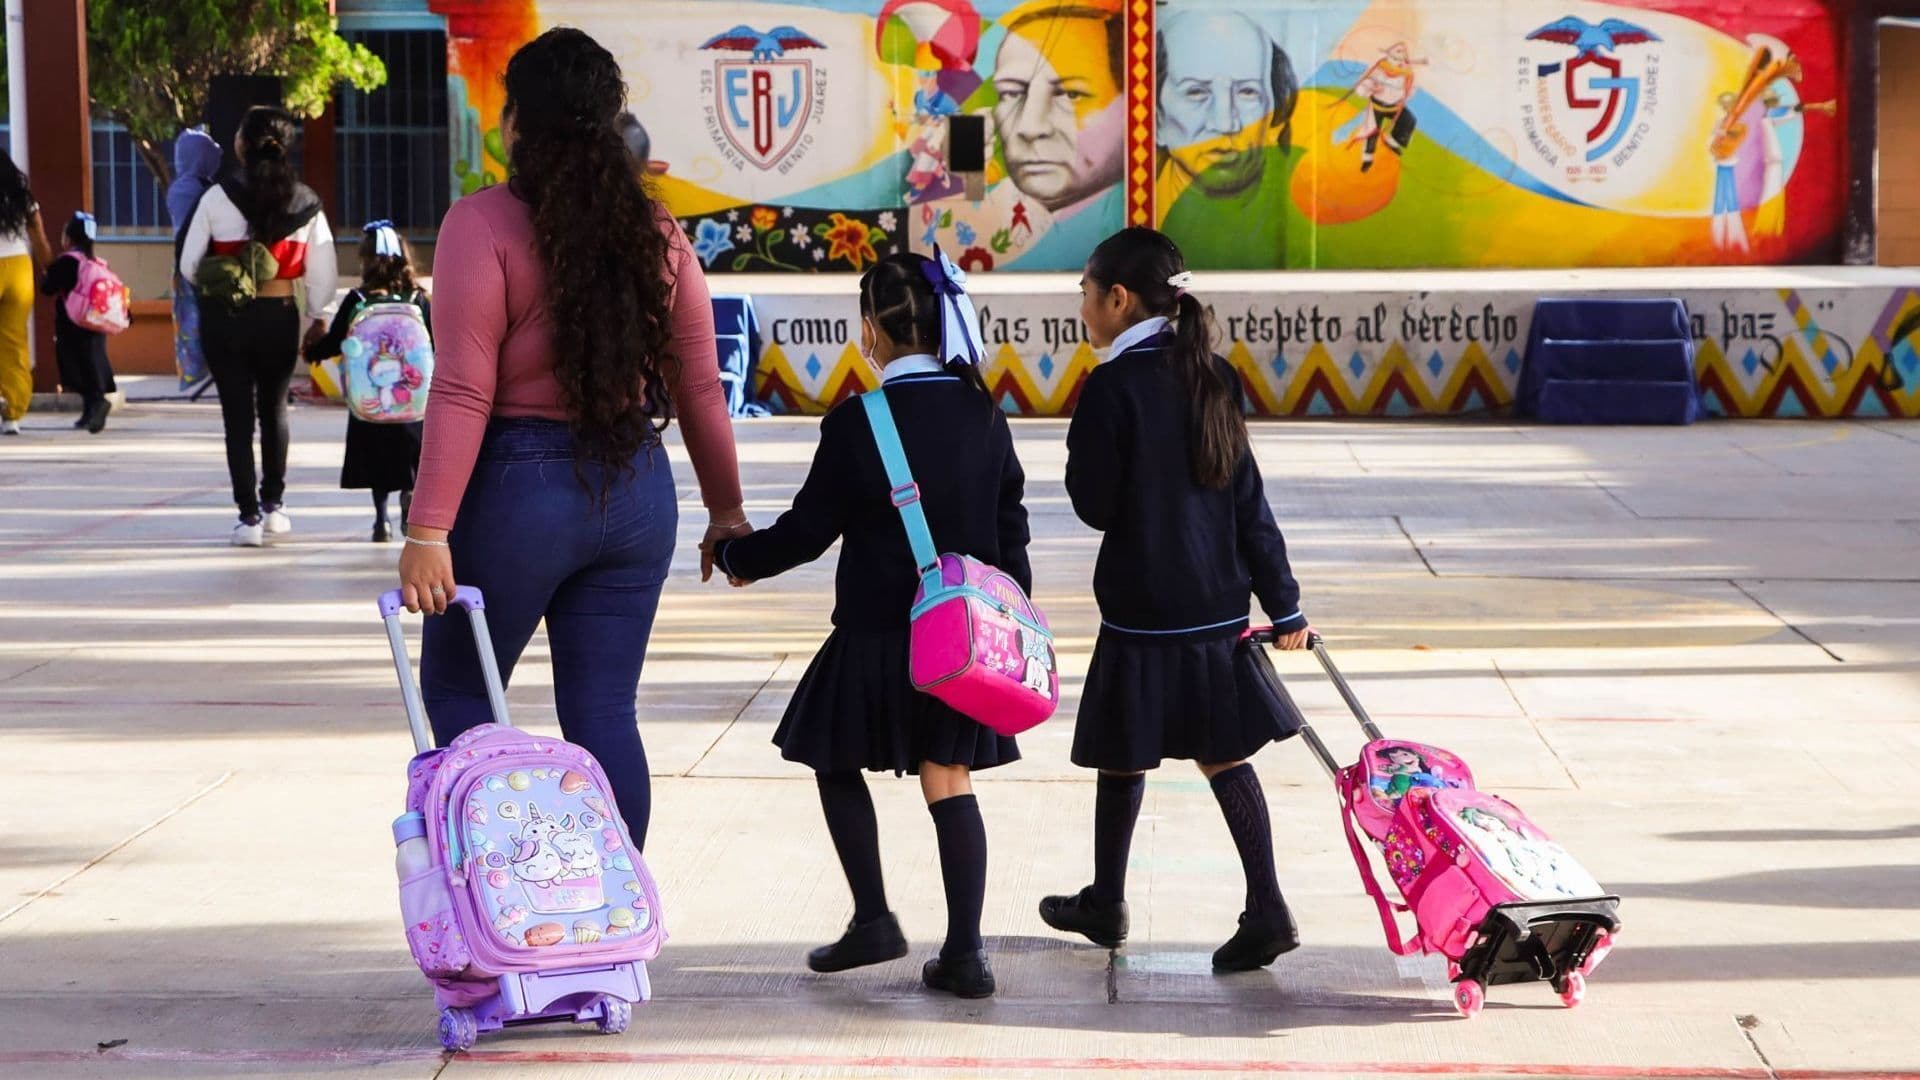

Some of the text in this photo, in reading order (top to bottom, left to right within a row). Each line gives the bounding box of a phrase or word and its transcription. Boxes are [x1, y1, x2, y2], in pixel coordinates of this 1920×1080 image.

[704, 106, 745, 172] PRIMARIA
[778, 134, 814, 175] BENITO
[1613, 122, 1650, 167] BENITO
[772, 318, 848, 345] como
[979, 304, 1030, 344] las
[1228, 305, 1342, 355] respeto
[1355, 302, 1386, 343] al
[1401, 302, 1518, 351] derecho
[1721, 300, 1784, 375] paz
